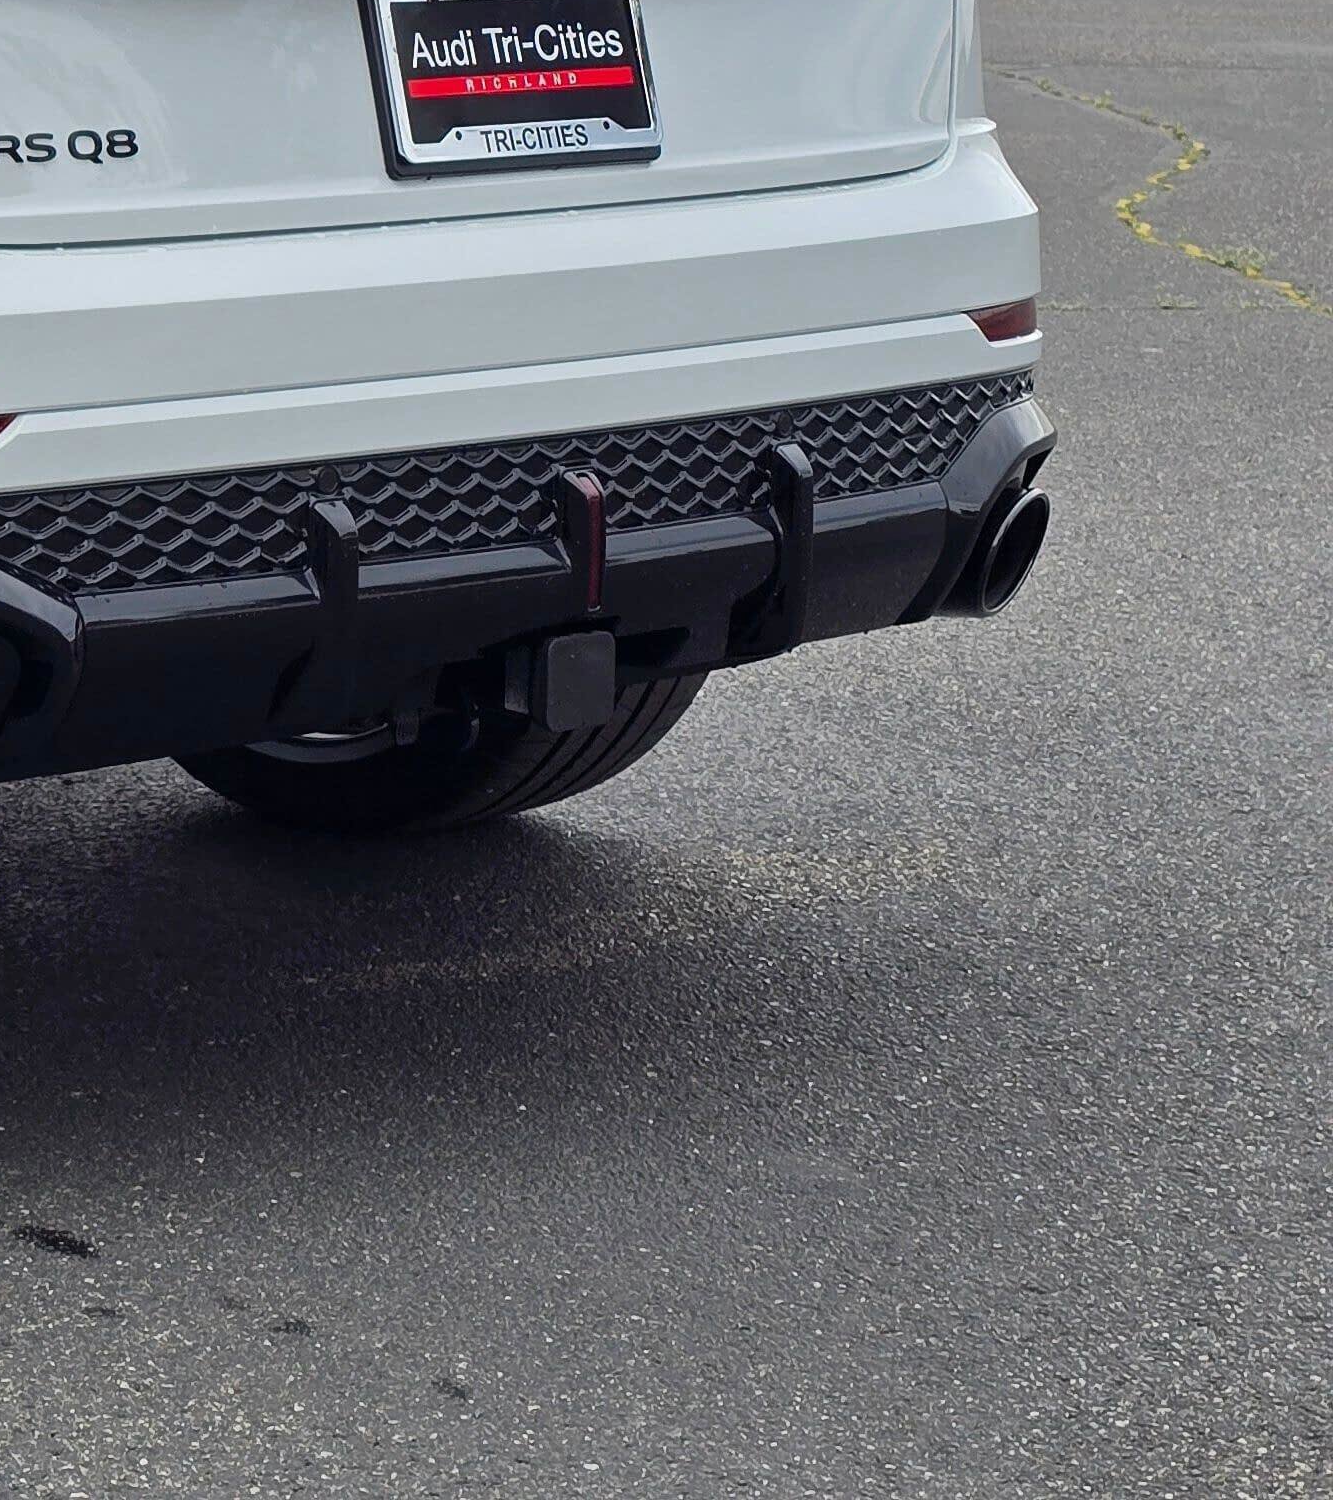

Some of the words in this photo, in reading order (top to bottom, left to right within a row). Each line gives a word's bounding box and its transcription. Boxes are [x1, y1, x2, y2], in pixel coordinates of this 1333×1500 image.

[412, 28, 477, 69] Audi
[481, 23, 624, 64] Tri-Cities
[465, 71, 578, 92] RICHLAND
[67, 129, 139, 164] Q8
[480, 123, 589, 154] TRI-CITIES
